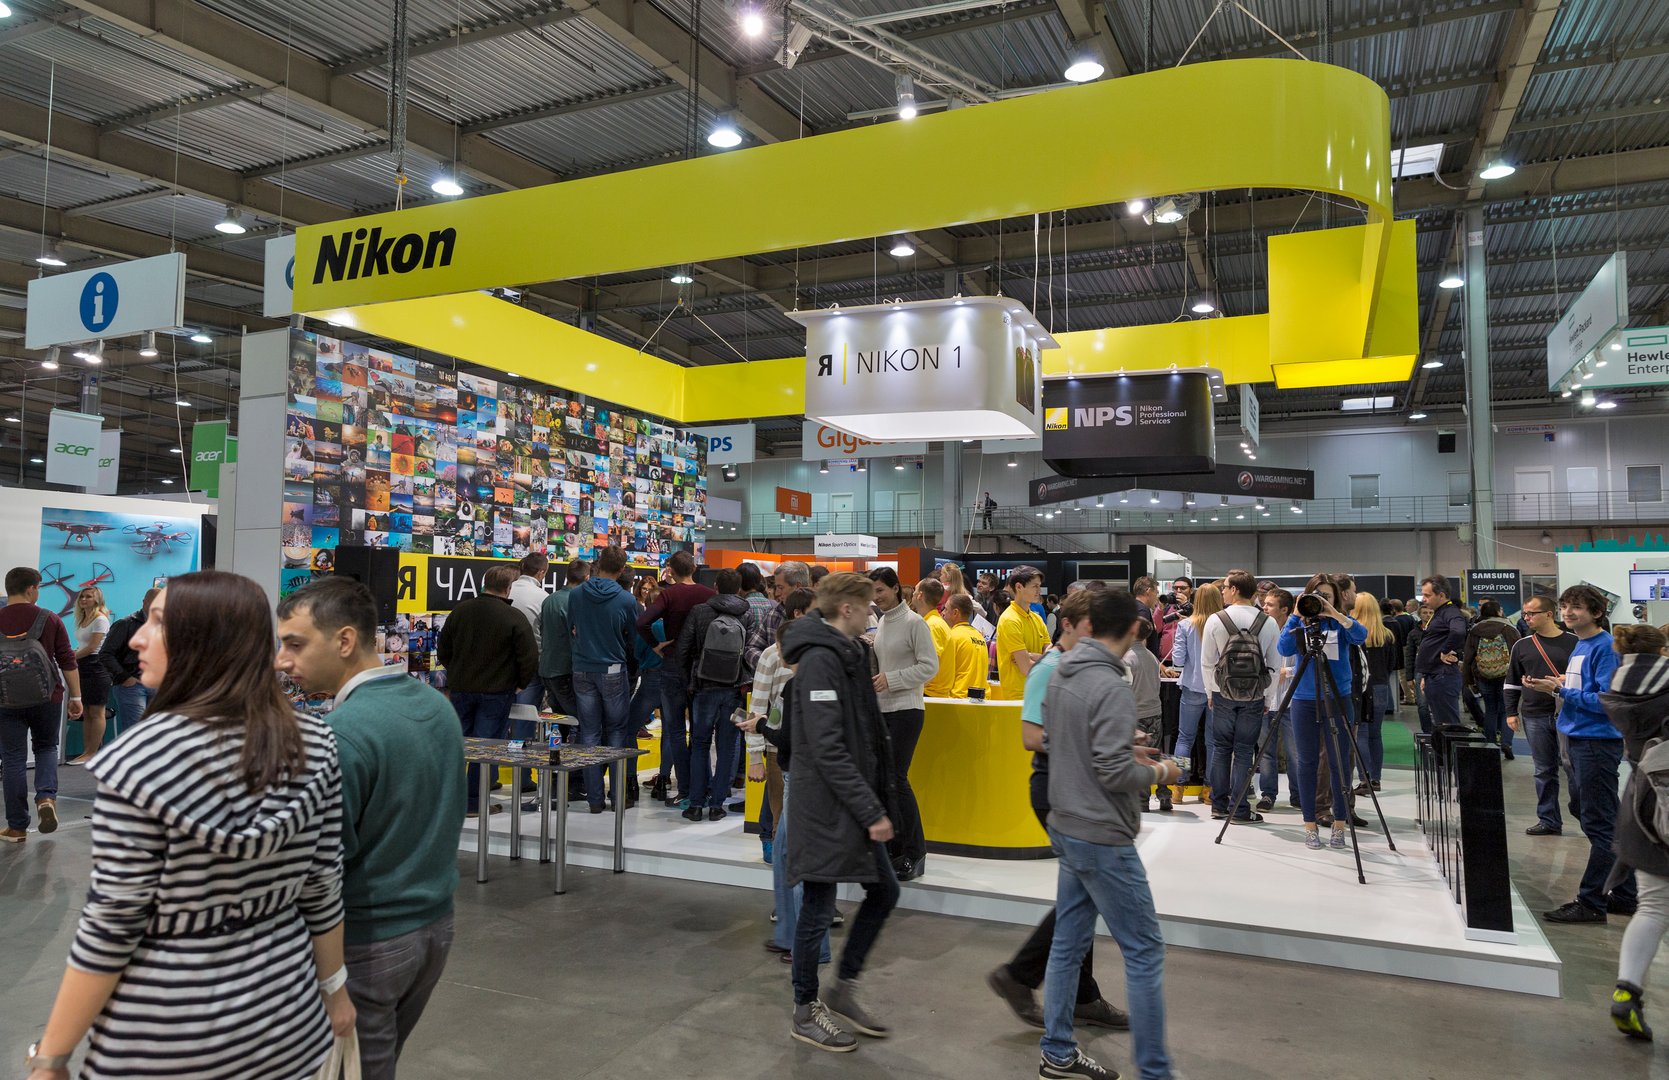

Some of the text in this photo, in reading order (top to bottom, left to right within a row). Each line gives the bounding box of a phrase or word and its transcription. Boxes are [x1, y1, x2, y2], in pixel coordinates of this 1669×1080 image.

[313, 227, 457, 285] Nikon
[817, 345, 962, 376] Я NIKON 1
[1074, 405, 1133, 428] NPS
[1139, 410, 1187, 418] Professional
[54, 442, 94, 457] acer
[195, 450, 222, 462] acer
[98, 457, 115, 468] cer
[1254, 474, 1306, 485] WARGAMING.NET
